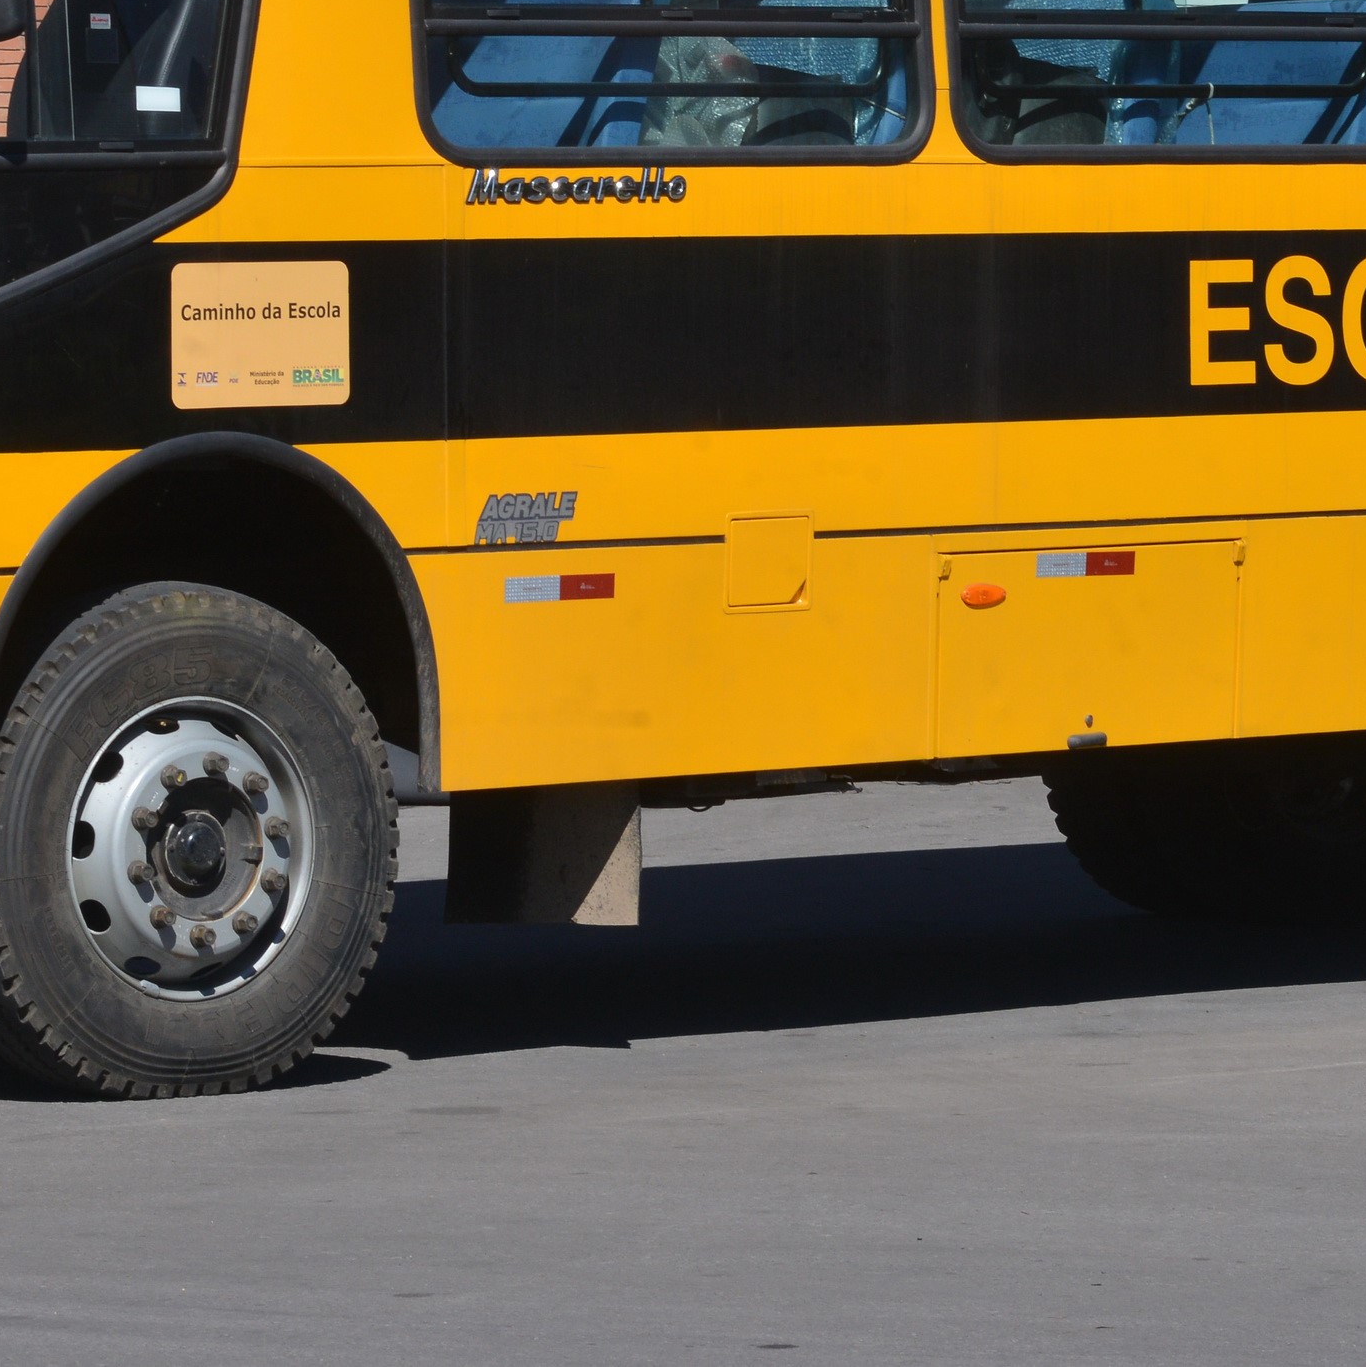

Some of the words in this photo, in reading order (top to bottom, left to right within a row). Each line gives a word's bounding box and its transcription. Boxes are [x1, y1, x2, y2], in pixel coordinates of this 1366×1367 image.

[467, 167, 688, 204] Mascarello
[181, 303, 256, 321] Caminho
[262, 302, 282, 319] da
[288, 301, 341, 319] Escola
[292, 368, 344, 384] BRASIL
[478, 491, 578, 521] AGRALE
[474, 522, 507, 546] MA
